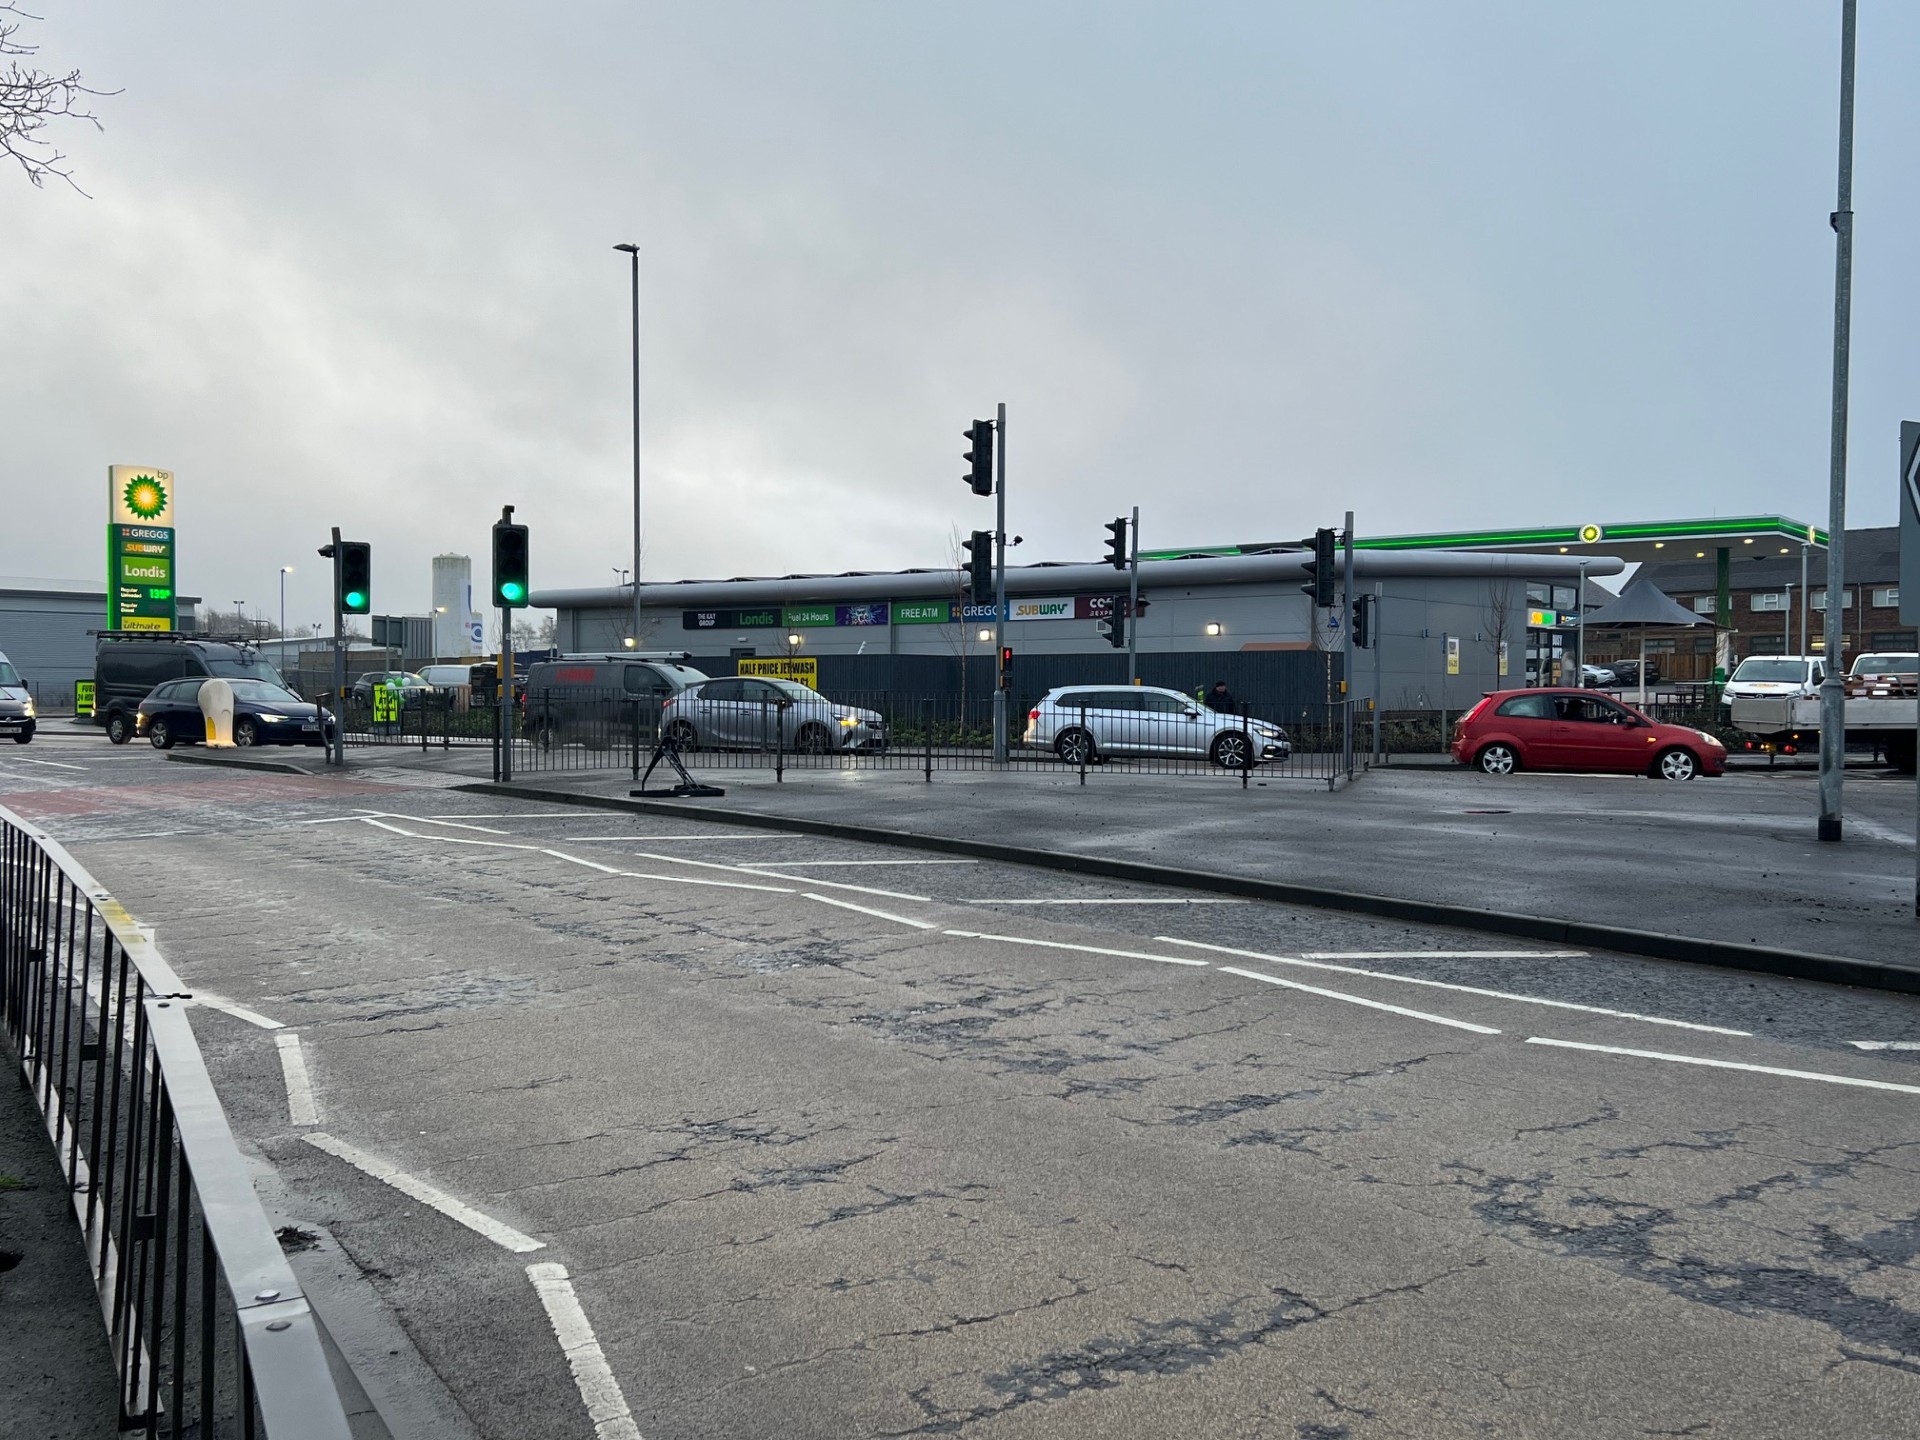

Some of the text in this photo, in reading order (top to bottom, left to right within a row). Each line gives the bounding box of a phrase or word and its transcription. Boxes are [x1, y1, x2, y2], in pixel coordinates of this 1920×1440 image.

[157, 470, 169, 480] bp
[131, 528, 169, 539] GREGGS
[125, 543, 166, 553] SUBWAY
[125, 564, 166, 578] Londis
[901, 608, 938, 618] FREE ATM
[1016, 603, 1068, 616] SUBWAY
[740, 612, 774, 625] Londis
[788, 613, 830, 622] Fuel 24 Hours
[123, 622, 161, 630] ultimate
[740, 663, 757, 675] HALF
[758, 663, 778, 675] PRICE
[792, 662, 815, 674] WASH
